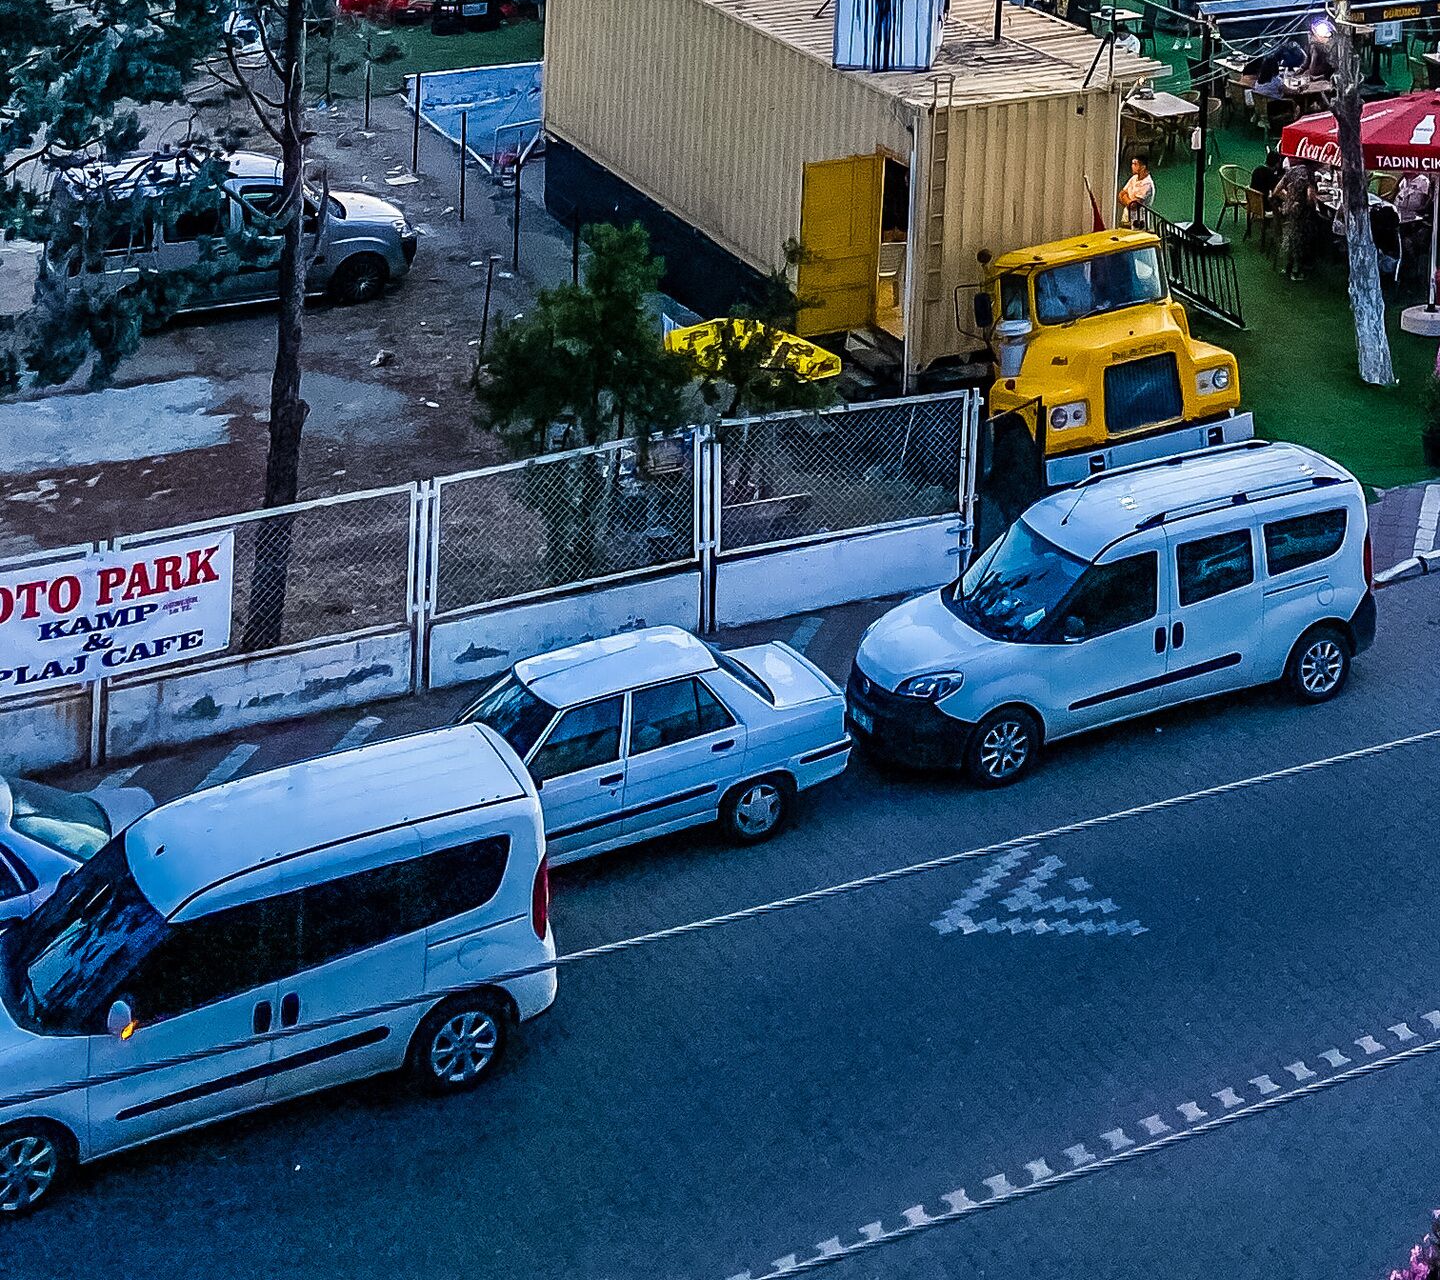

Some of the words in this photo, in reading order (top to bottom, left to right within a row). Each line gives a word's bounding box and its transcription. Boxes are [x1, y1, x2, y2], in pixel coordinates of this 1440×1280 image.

[1376, 155, 1419, 169] TADINI
[96, 545, 219, 606] PARK
[37, 603, 159, 641] KAMP
[82, 633, 114, 652] &
[102, 630, 204, 668] CAFE
